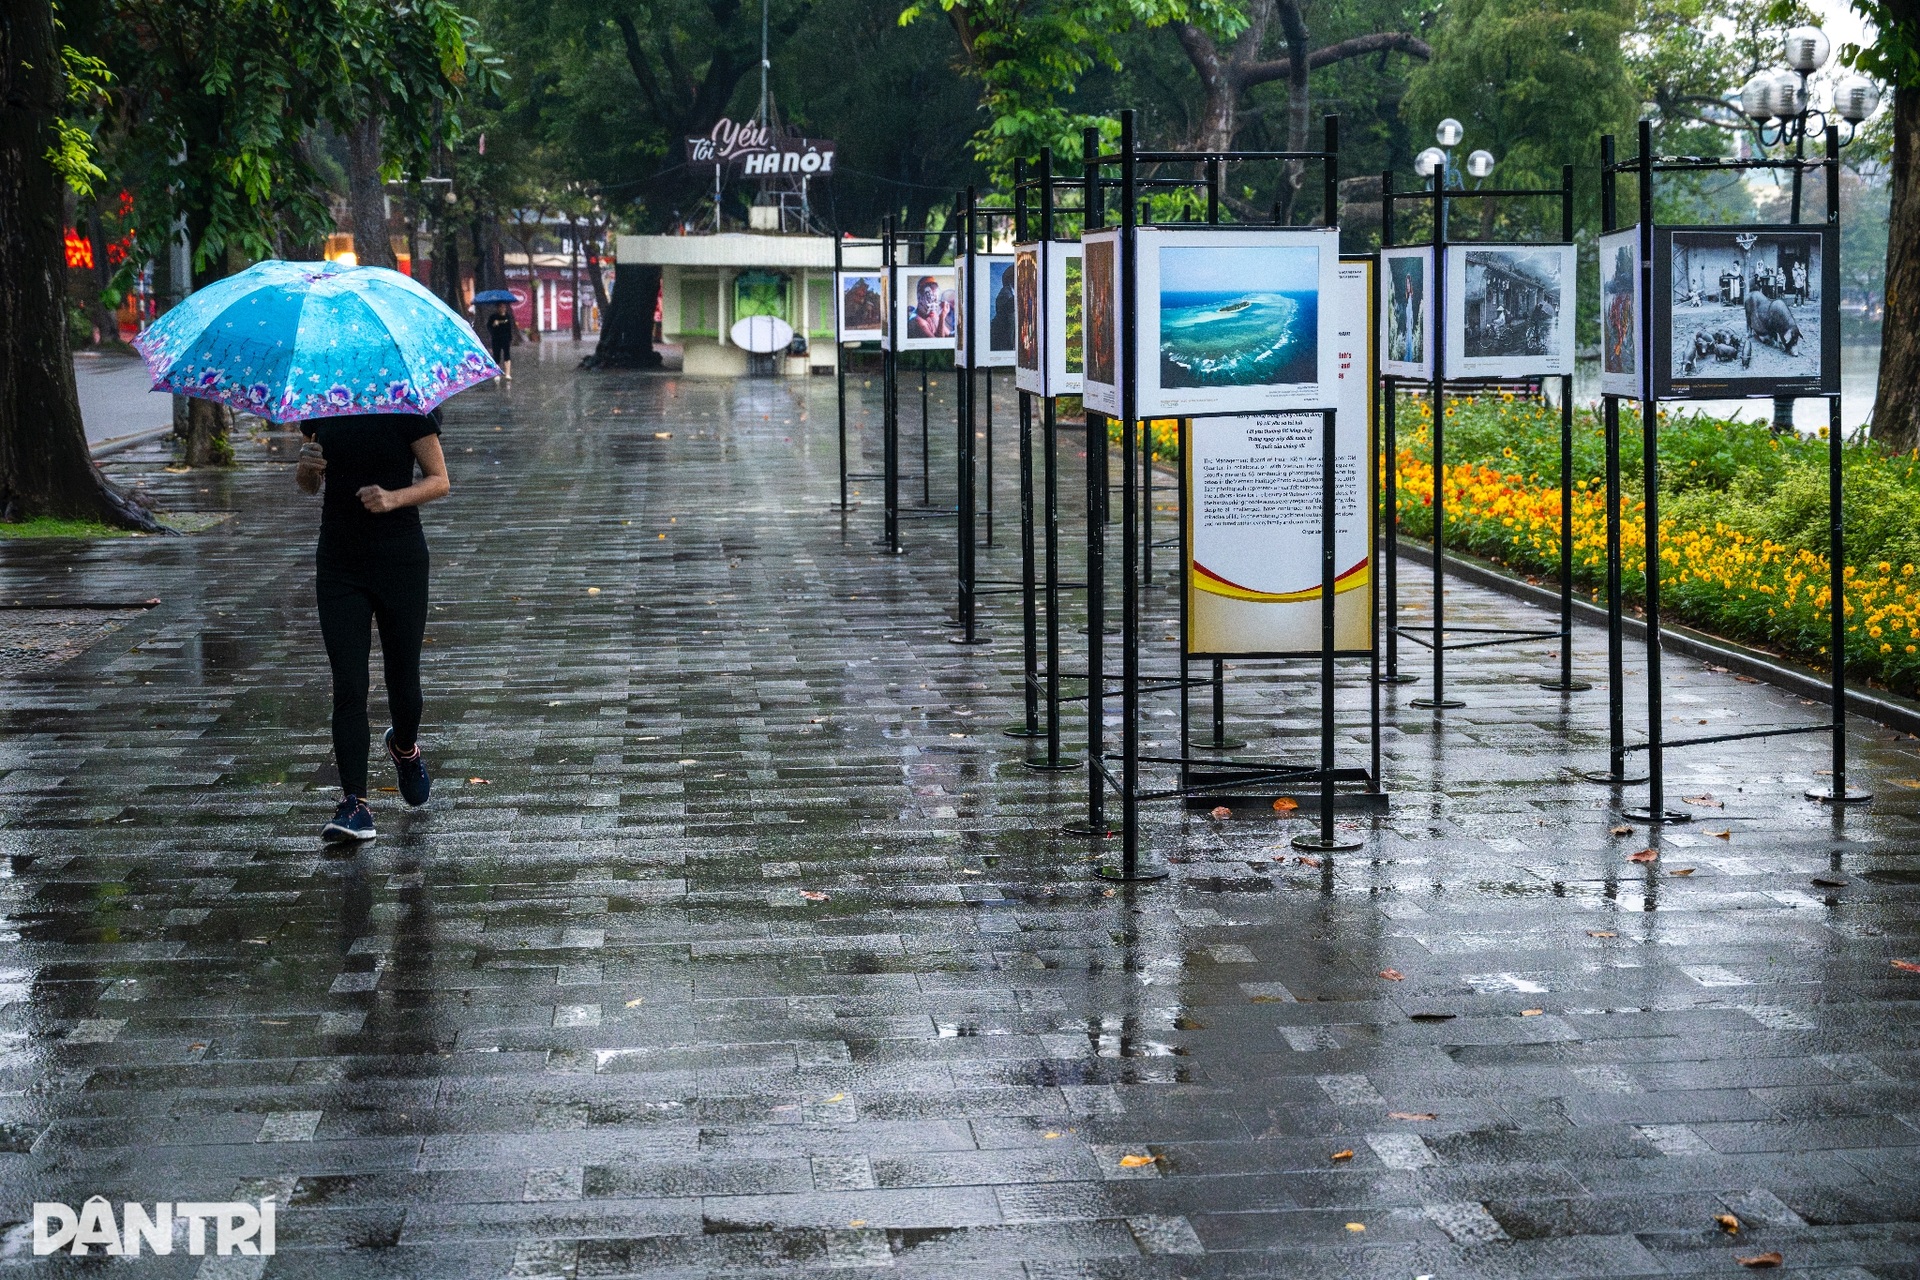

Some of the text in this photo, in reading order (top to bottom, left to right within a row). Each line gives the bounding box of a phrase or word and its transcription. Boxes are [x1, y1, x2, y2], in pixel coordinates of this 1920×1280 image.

[688, 118, 768, 161] Tôi Yêu
[744, 146, 780, 174] HÀ
